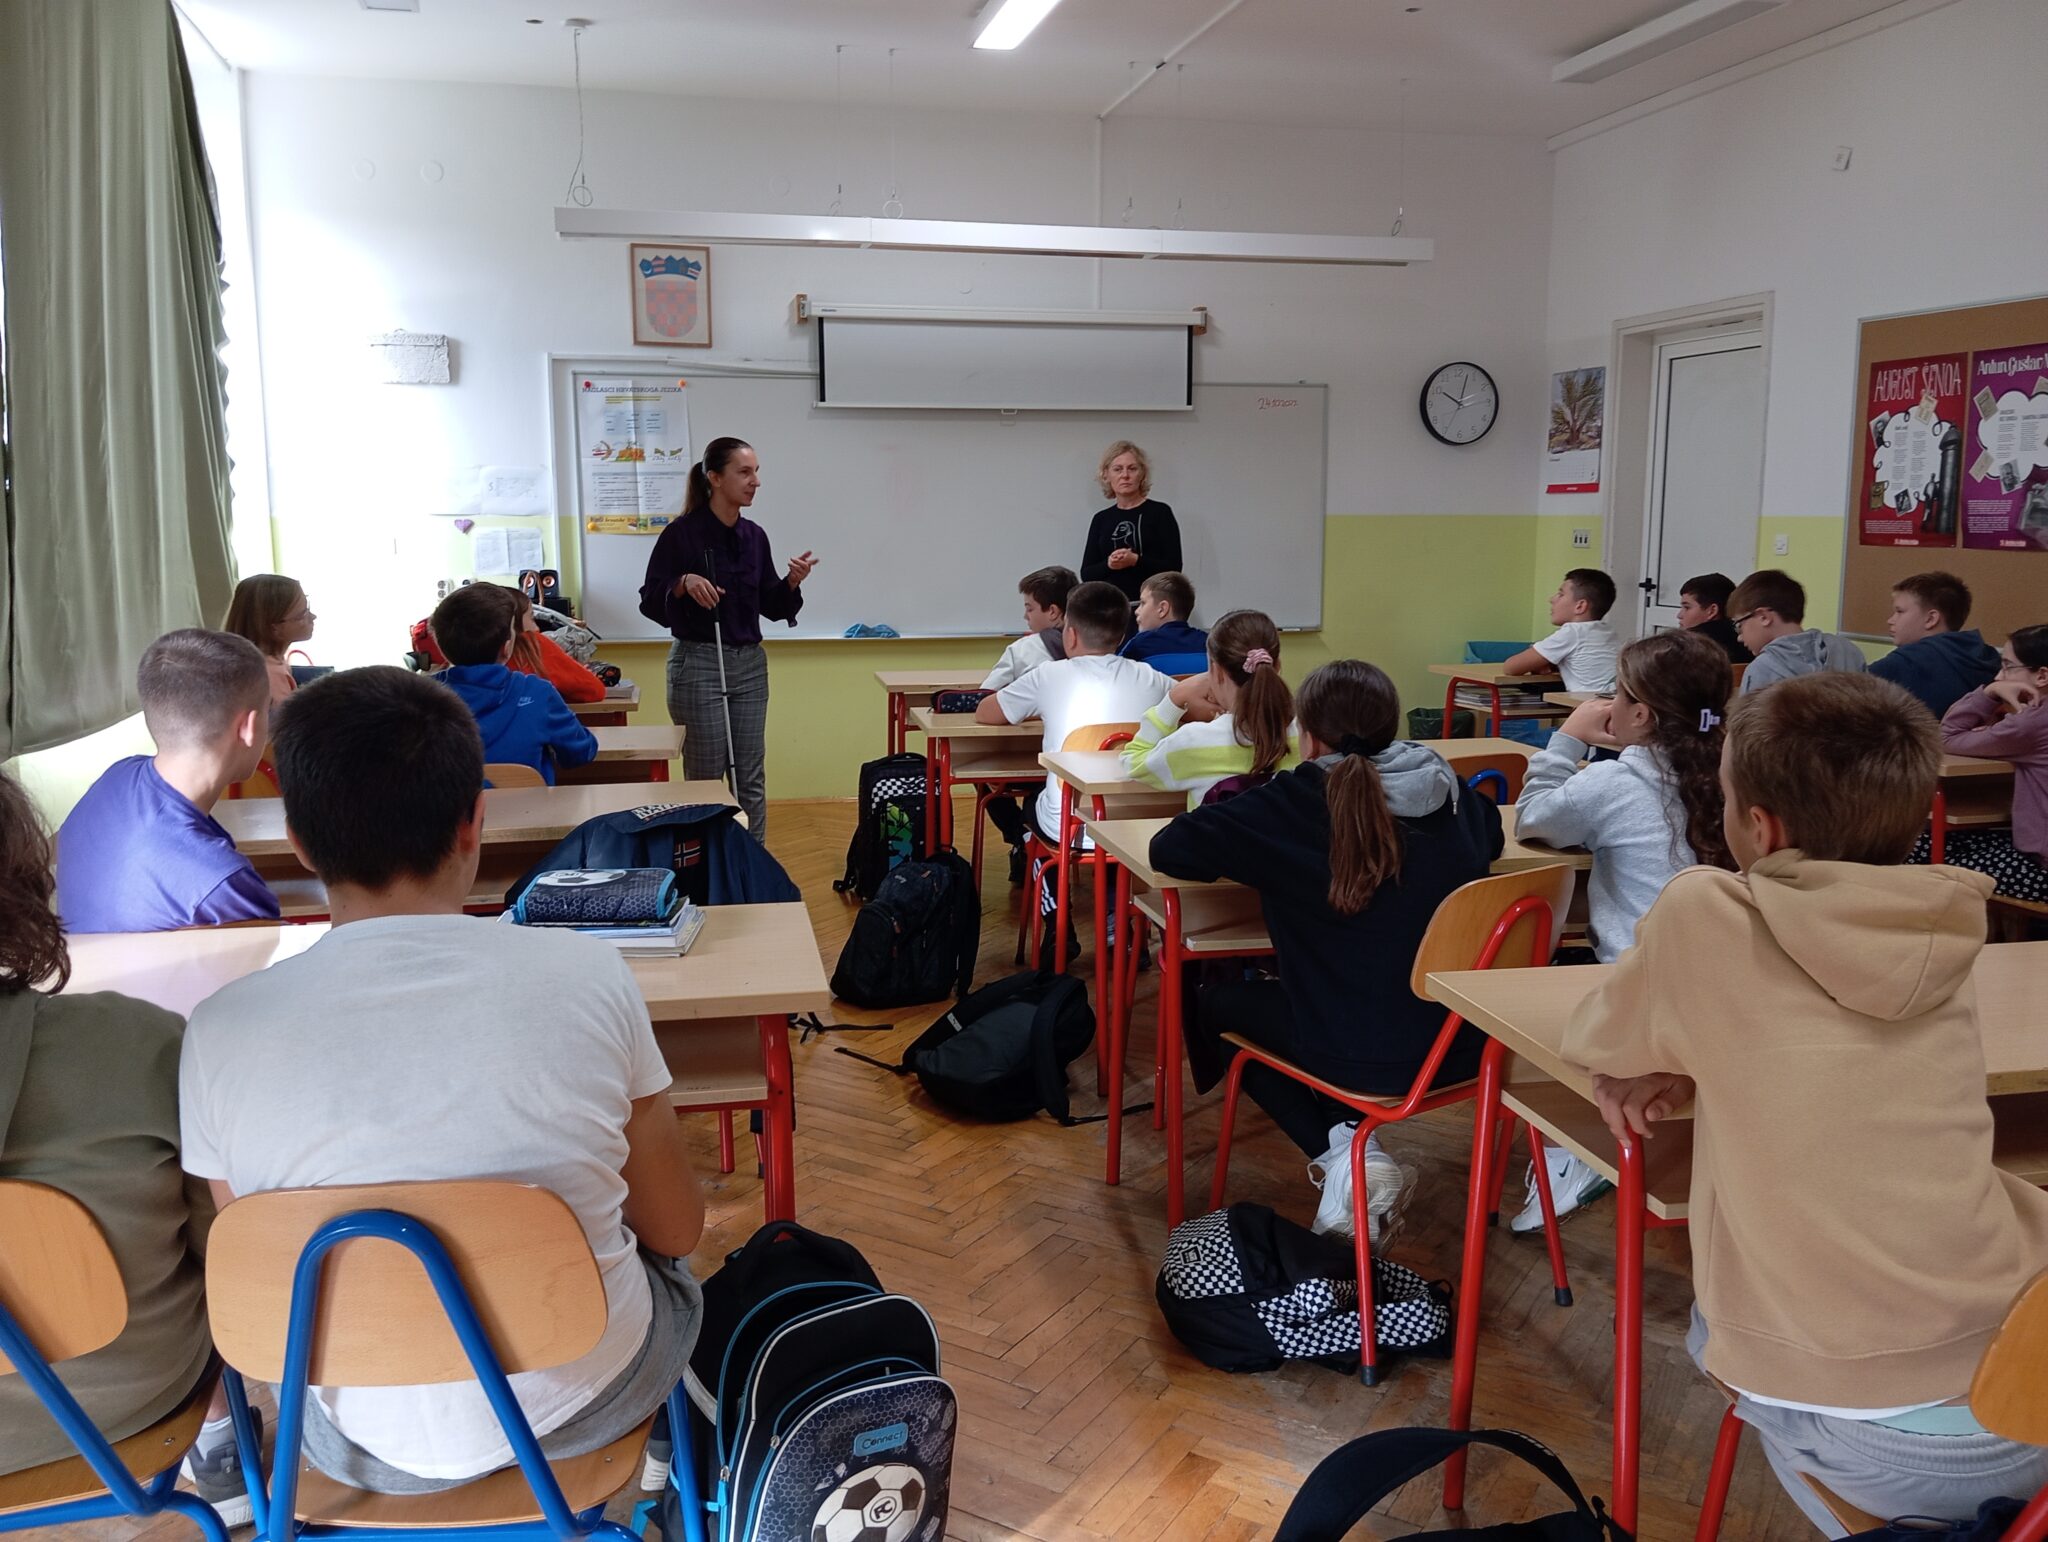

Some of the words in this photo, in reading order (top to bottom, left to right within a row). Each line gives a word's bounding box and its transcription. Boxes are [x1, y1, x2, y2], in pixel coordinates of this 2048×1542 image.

[1454, 368, 1464, 377] 12
[1977, 360, 2007, 375] Antun
[1873, 366, 1919, 402] AUGUST
[1921, 362, 1961, 398] ŠENOA
[862, 1432, 903, 1449] Connect
